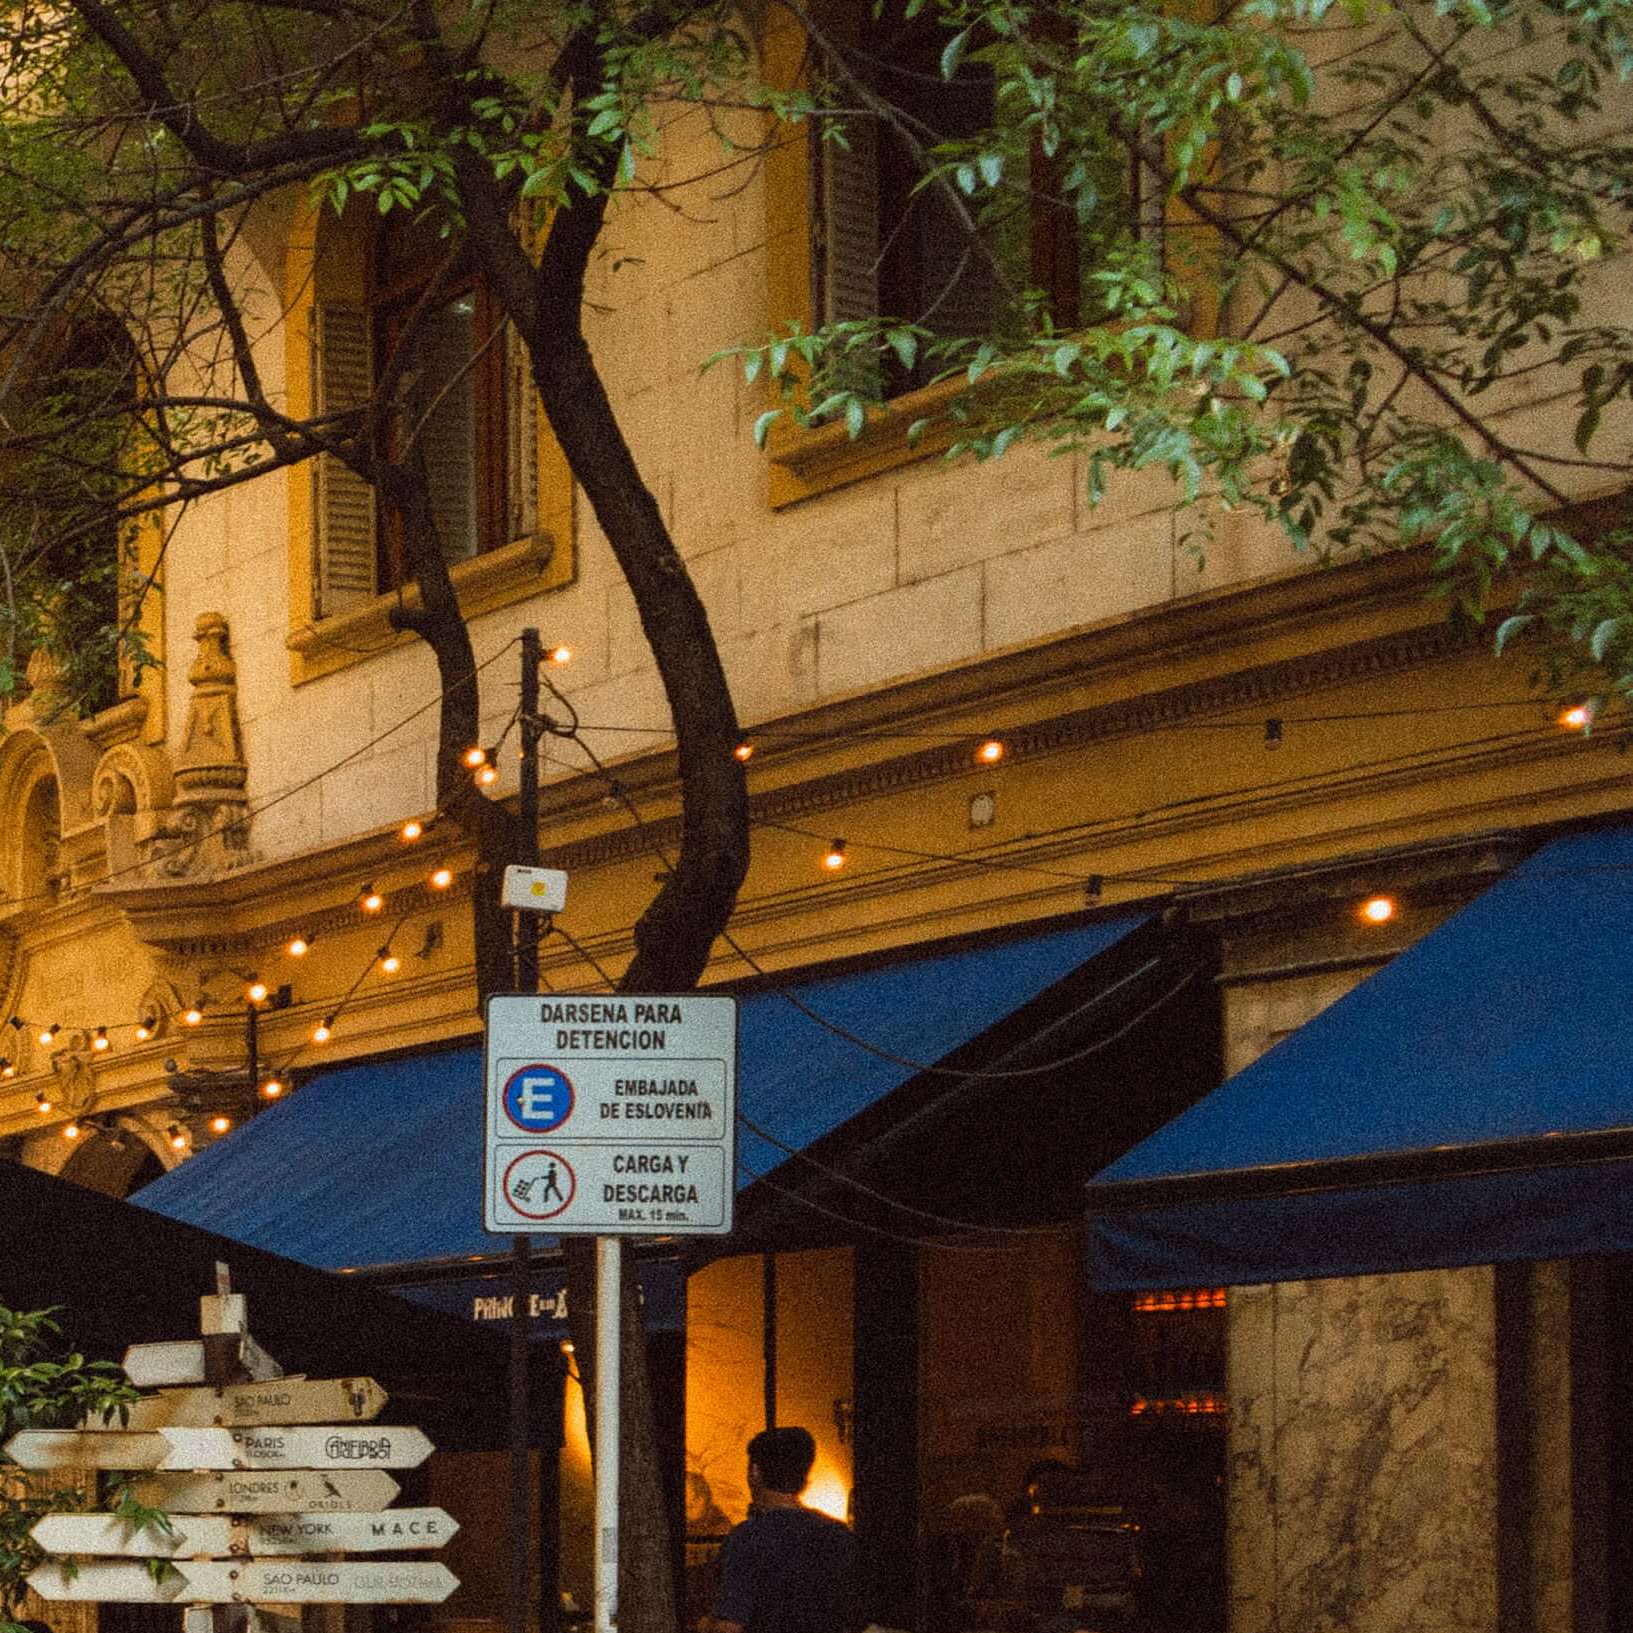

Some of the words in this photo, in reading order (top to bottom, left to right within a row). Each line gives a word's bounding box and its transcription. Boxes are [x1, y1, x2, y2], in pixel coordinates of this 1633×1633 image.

[541, 1003, 628, 1023] DARSENA
[635, 1004, 682, 1024] PARA
[557, 1030, 665, 1050] DETENCION
[615, 1079, 698, 1096] EMBAJADA
[522, 1077, 555, 1120] E
[600, 1103, 620, 1119] DE
[613, 1155, 674, 1174] CARGA
[678, 1156, 689, 1172] Y
[603, 1184, 699, 1203] DESCARGA
[650, 1208, 663, 1221] 15
[246, 1436, 286, 1450] PARIS
[229, 1482, 280, 1495] LONDRES
[260, 1524, 294, 1537] NEW
[298, 1522, 333, 1536] YORK
[296, 1573, 340, 1586] PAULO
